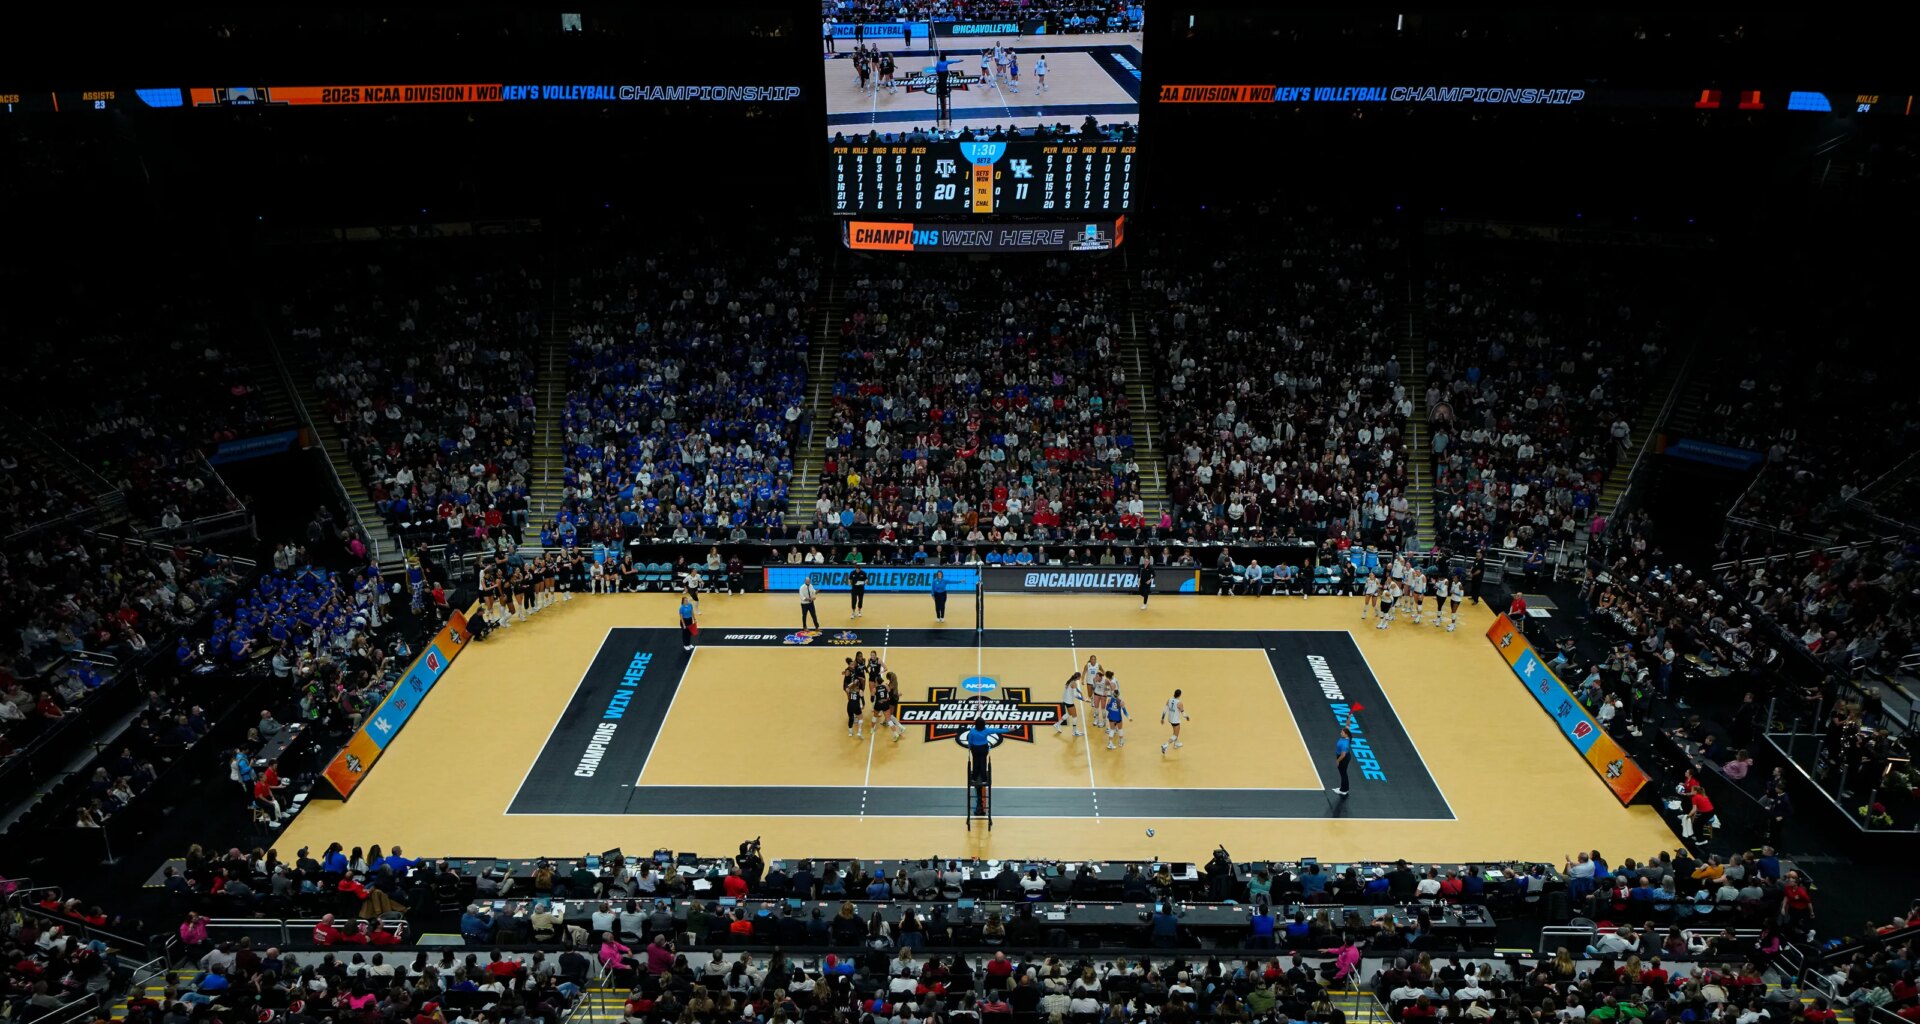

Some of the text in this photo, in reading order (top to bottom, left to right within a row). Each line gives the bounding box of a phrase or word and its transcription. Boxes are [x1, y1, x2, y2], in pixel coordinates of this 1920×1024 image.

[83, 92, 115, 100] ASSISTS
[322, 83, 800, 103] 2025 NCAA DIVISION I WOMEN'S VOLLEYBALL CHAMPIONSHIP
[1182, 87, 1239, 100] DIVISION
[1242, 87, 1248, 100] I
[1250, 87, 1311, 101] WOMEN'S
[1314, 88, 1387, 102] VOLLEYBALL
[1390, 87, 1585, 104] CHAMPIONSHIP
[1856, 95, 1879, 103] KILLS
[8, 104, 12, 112] 1
[94, 100, 105, 109] 23
[1857, 104, 1870, 112] 24
[972, 145, 996, 155] 1:30
[838, 155, 920, 164] 1 4 0 2 1
[1047, 155, 1131, 163] 6 0 4 1 0
[837, 164, 921, 173] 4 3 3 0 0
[1010, 159, 1034, 178] UK
[1047, 164, 1130, 172] 7 8 4 0 0
[838, 173, 921, 182] 9 7 5 1 0
[966, 171, 969, 179] 1
[995, 171, 1001, 180] 0
[1045, 173, 1129, 181] 12 0 6 0 1
[837, 183, 921, 191] 16 1 4 2 0
[1045, 182, 1129, 190] 15 4 1 2 0
[934, 184, 956, 200] 20
[1016, 183, 1028, 199] 11
[1045, 191, 1129, 199] 17 6 7 0 0
[837, 192, 922, 200] 21 2 1 2 0
[837, 201, 922, 209] 37 7 6 1 0
[964, 200, 970, 208] 2
[1043, 200, 1129, 209] 20 3 2 2 0
[856, 229, 1064, 245] CHAMPIONS WIN HERE
[574, 652, 652, 777] CHAMPIONS WIN HERE
[903, 711, 1054, 720] CHAMPIONSHIP
[1306, 655, 1344, 700] CHAMPIONS
[1350, 738, 1388, 783] HERE
